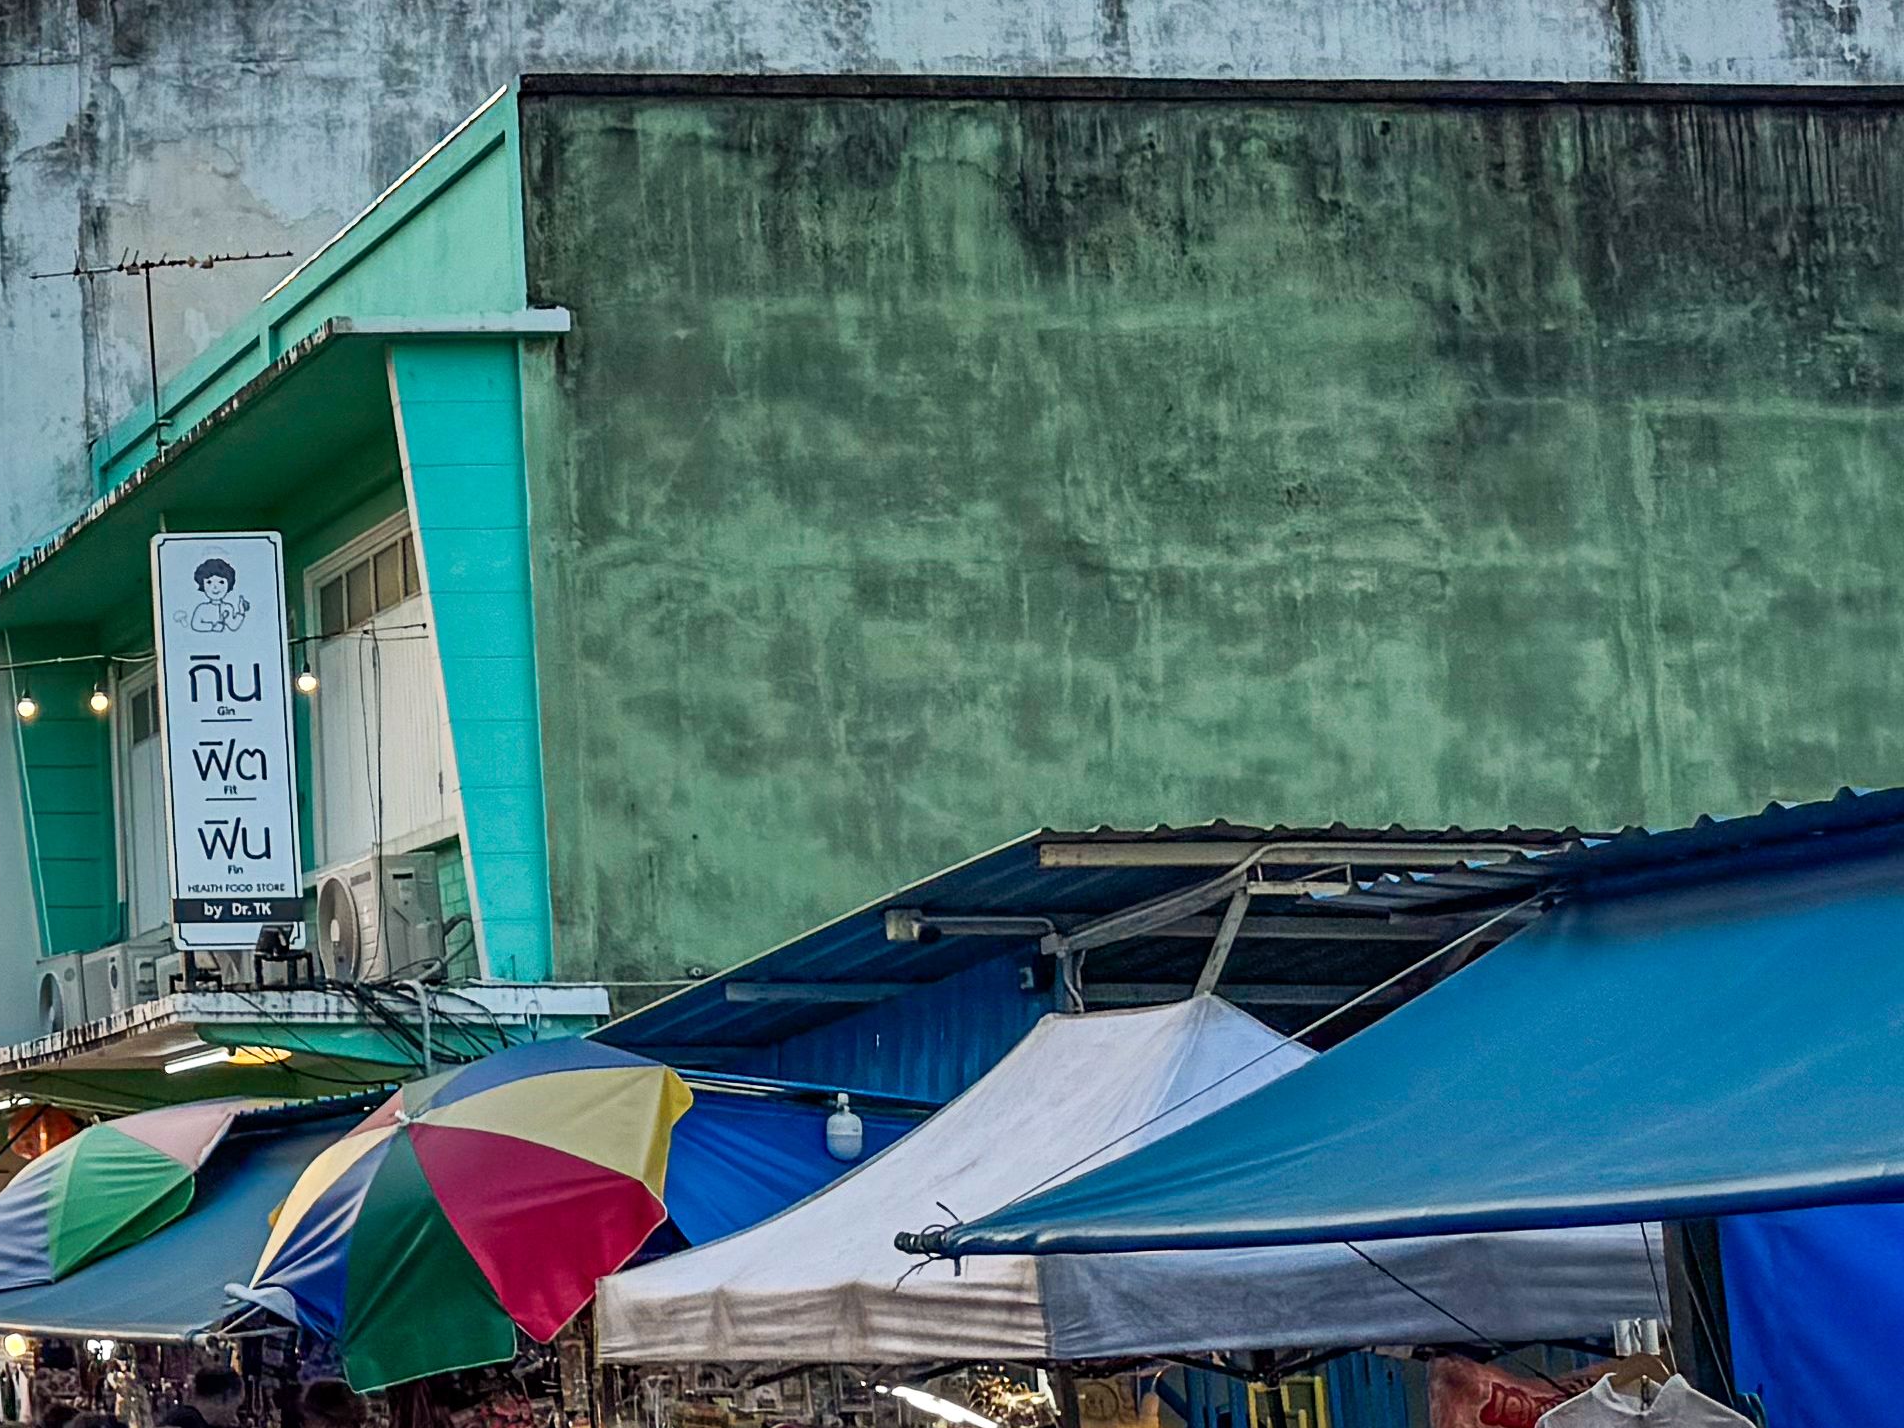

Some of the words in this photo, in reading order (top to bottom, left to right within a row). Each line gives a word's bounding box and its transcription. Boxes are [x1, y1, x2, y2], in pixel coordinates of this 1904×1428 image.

[188, 654, 262, 703] กิน
[216, 705, 236, 717] Gin
[192, 738, 268, 782] ฟิต
[223, 784, 239, 795] Fit
[197, 816, 272, 861] ฟิน
[227, 864, 244, 875] Fin
[187, 883, 223, 893] HEALTH
[225, 883, 253, 893] FOOD
[256, 882, 286, 892] STORE
[203, 902, 223, 920] by
